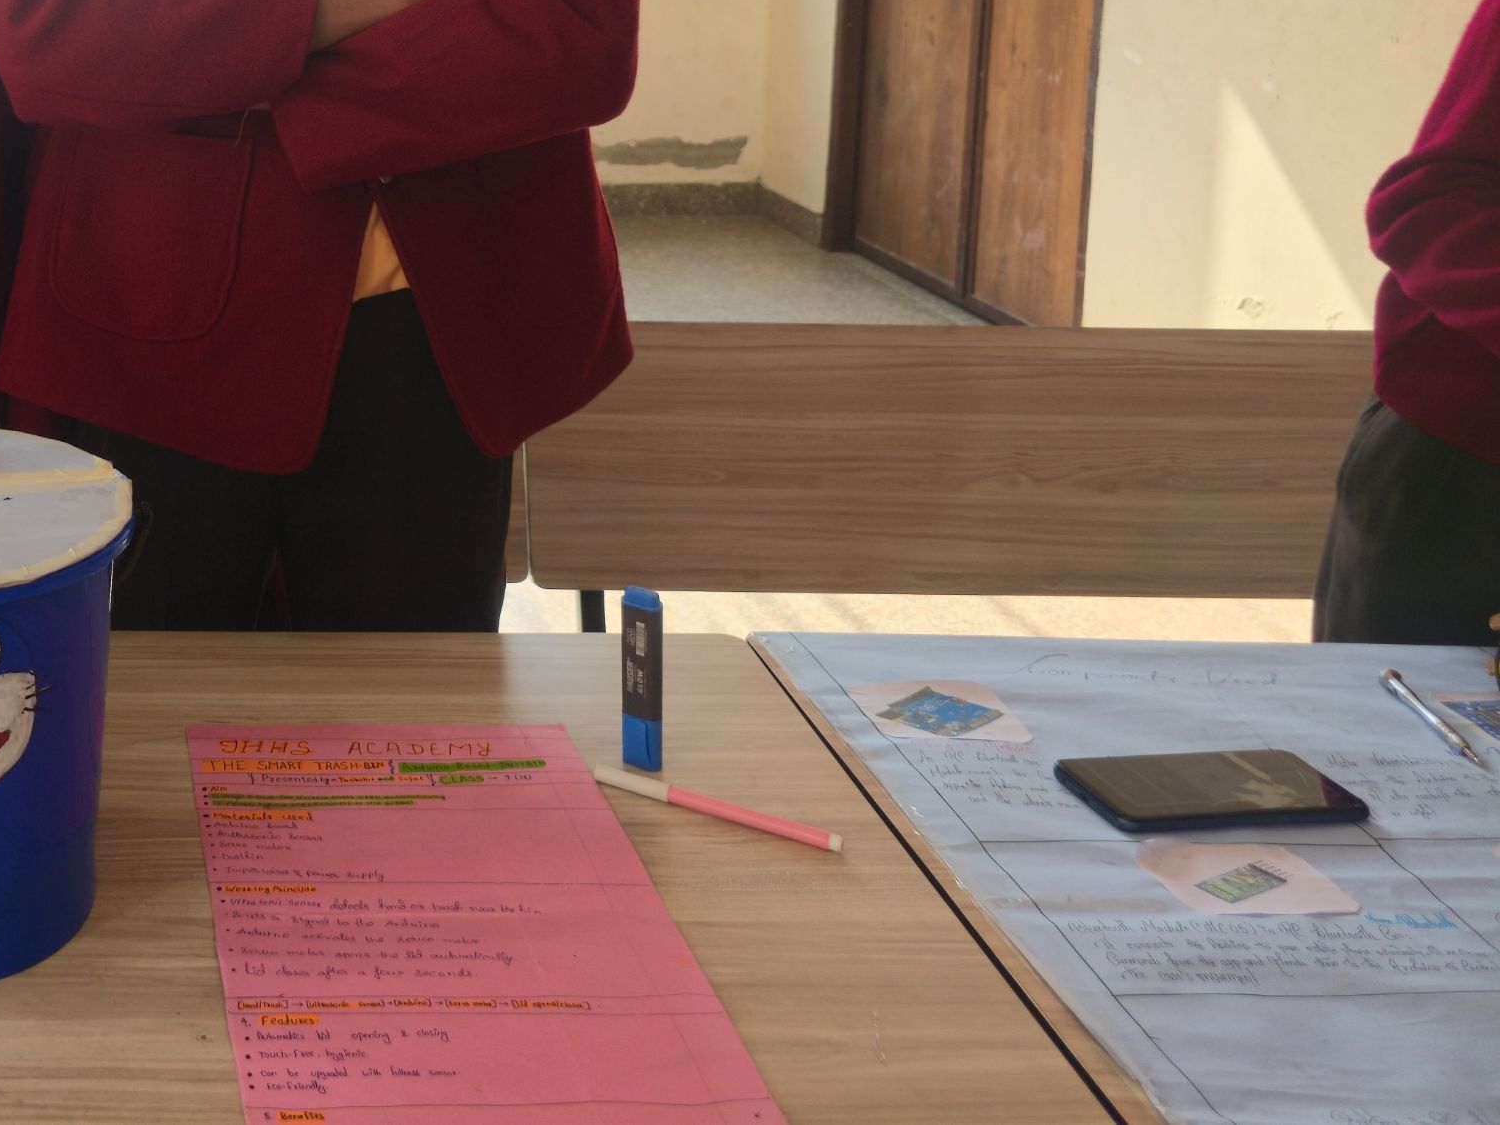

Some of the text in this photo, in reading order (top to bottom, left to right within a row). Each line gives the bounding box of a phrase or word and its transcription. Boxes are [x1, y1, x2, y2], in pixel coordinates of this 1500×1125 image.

[348, 741, 491, 757] ACADEMY
[207, 760, 245, 771] THE
[256, 760, 303, 771] SMART
[261, 1014, 316, 1026] Features
